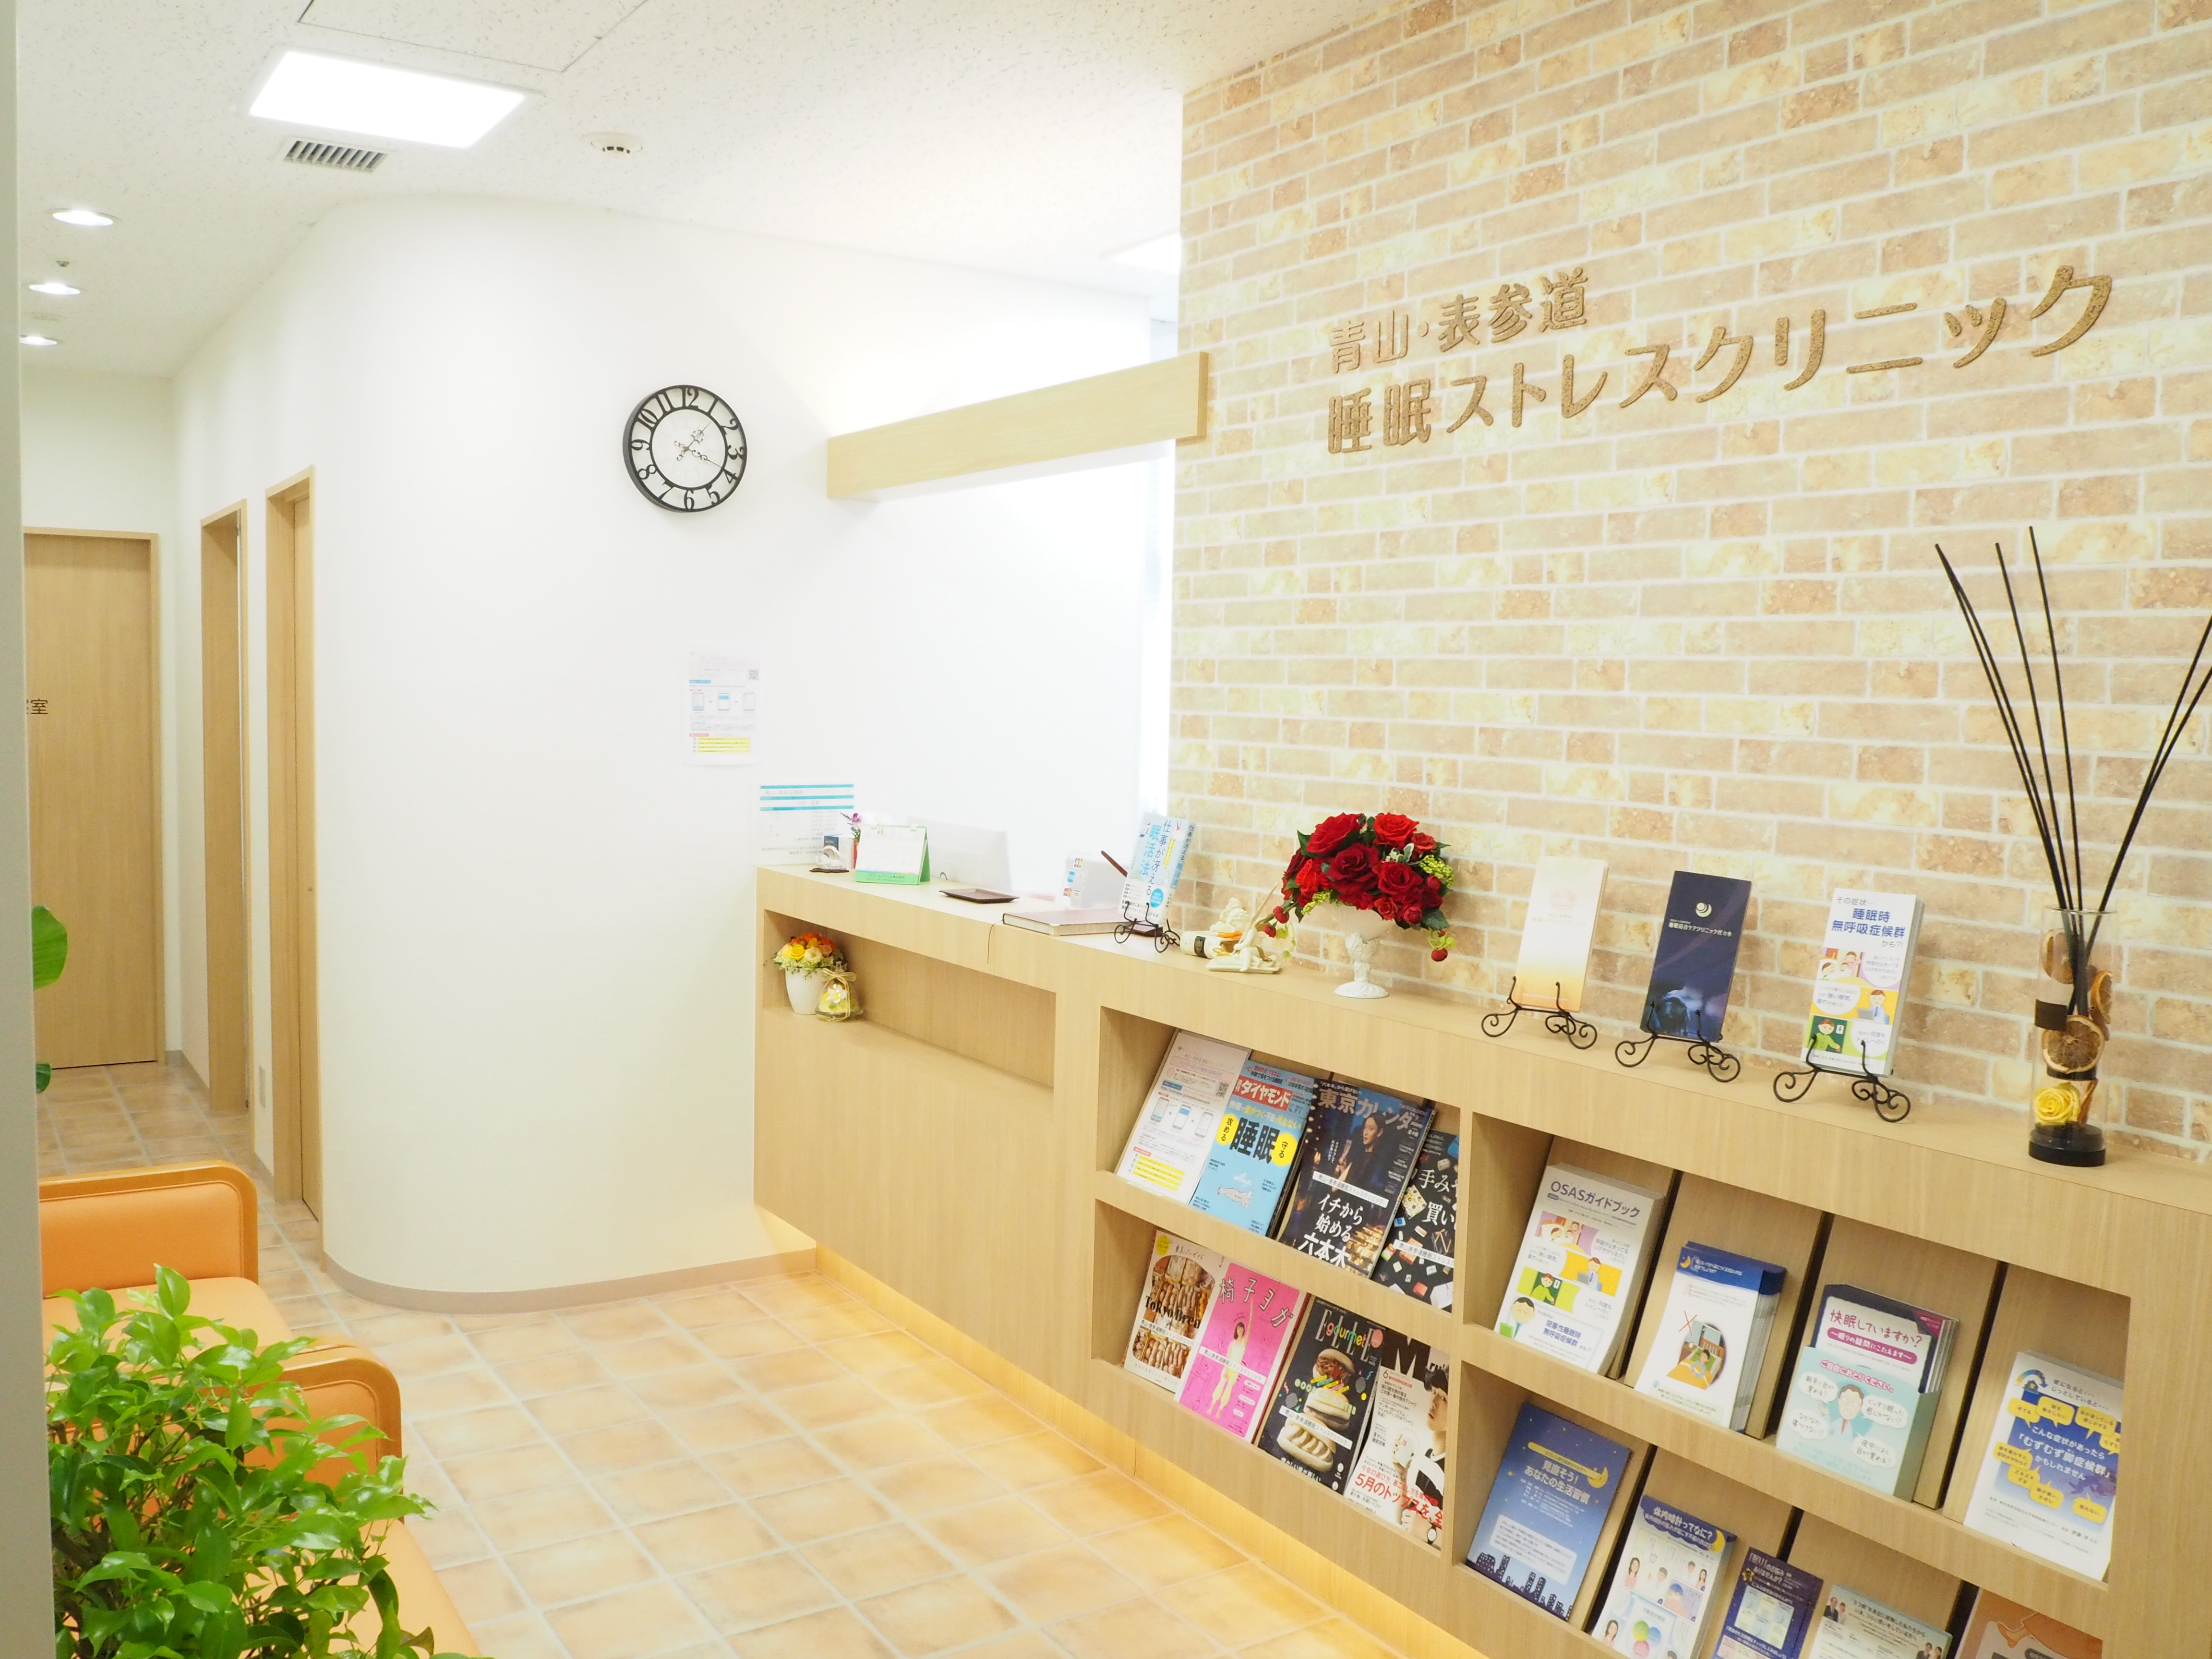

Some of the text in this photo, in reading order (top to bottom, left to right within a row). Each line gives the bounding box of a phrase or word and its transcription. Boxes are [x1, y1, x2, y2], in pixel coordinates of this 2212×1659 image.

[1329, 265, 1587, 374] 青山・表参道
[1327, 264, 2114, 456] 睡眠ストレスクリニック
[682, 387, 699, 409] 12
[720, 418, 739, 435] 2
[727, 445, 744, 460] 3
[637, 464, 657, 480] 8
[722, 468, 740, 484] 4
[658, 479, 675, 500] 7
[683, 489, 695, 510] 6
[706, 482, 720, 505] 5
[26, 698, 48, 714] 室
[1139, 824, 1162, 877] 眠活法
[1146, 819, 1172, 896] 仕事が冴える
[1830, 918, 1907, 940] 無呼吸症候群
[1851, 907, 1891, 923] 睡眠時
[1238, 1079, 1292, 1109] ダイヤモンド
[1220, 1117, 1234, 1142] 攻める
[1228, 1116, 1282, 1164] 睡眠
[1277, 1141, 1288, 1159] 守る
[1315, 1191, 1366, 1227] イチから
[1549, 1179, 1641, 1219] OSASガイドブック
[1313, 1212, 1354, 1243] 始める
[1298, 1232, 1350, 1268] 六本木
[1142, 1295, 1175, 1322] Tokyo
[1219, 1277, 1294, 1328] 椅子ヨガ
[1324, 1319, 1369, 1350] gourmet
[1830, 1310, 1923, 1348] 快眠していますか?
[1382, 1369, 1389, 1379] 6
[1820, 1359, 1895, 1393] ご自由におとりください。
[2018, 1433, 2111, 1479] 「むずむず脚症候群」
[2031, 1426, 2106, 1460] こんな症状があったら
[1542, 1460, 1579, 1484] 見直そう!
[2034, 1455, 2086, 1481] かもしれません
[1524, 1465, 1591, 1505] あなたの生活習慣
[1653, 1506, 1713, 1541] 体内時計ってなに?
